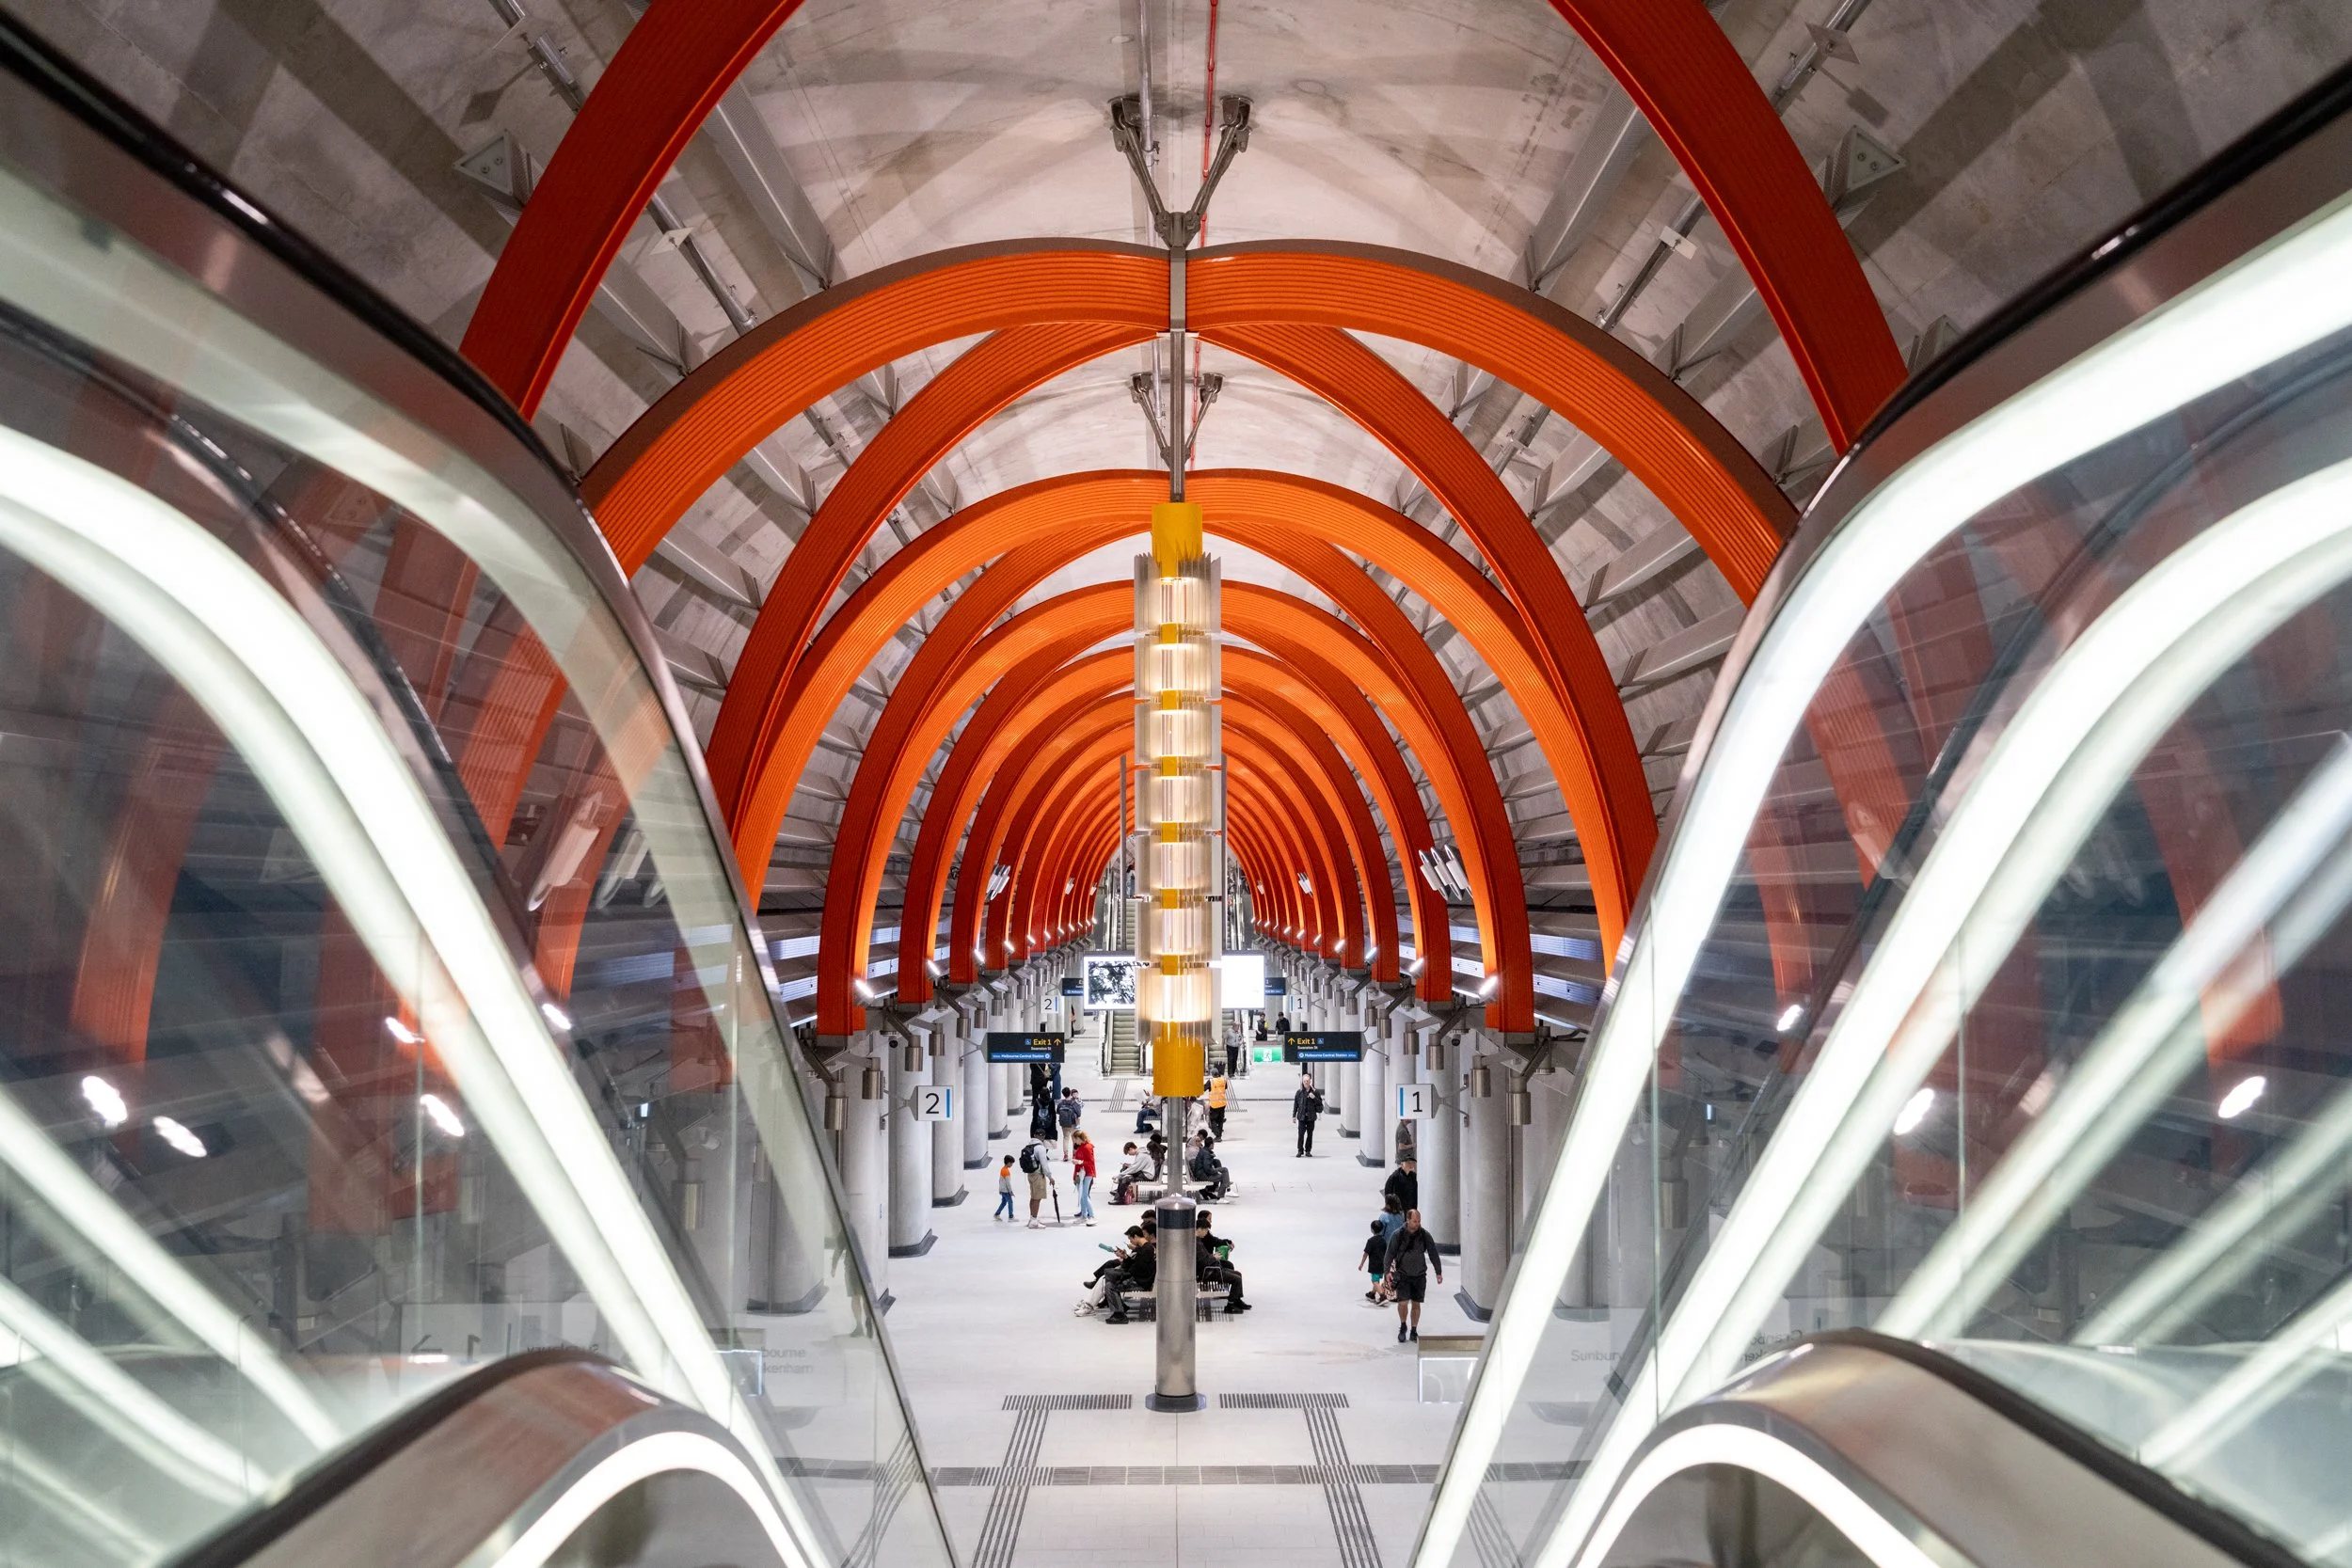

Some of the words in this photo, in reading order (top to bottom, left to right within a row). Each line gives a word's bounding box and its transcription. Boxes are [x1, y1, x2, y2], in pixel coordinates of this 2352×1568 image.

[1043, 998, 1053, 1010] 2
[1296, 997, 1303, 1010] 1
[925, 1092, 940, 1115] 2
[1412, 1091, 1423, 1113] 1
